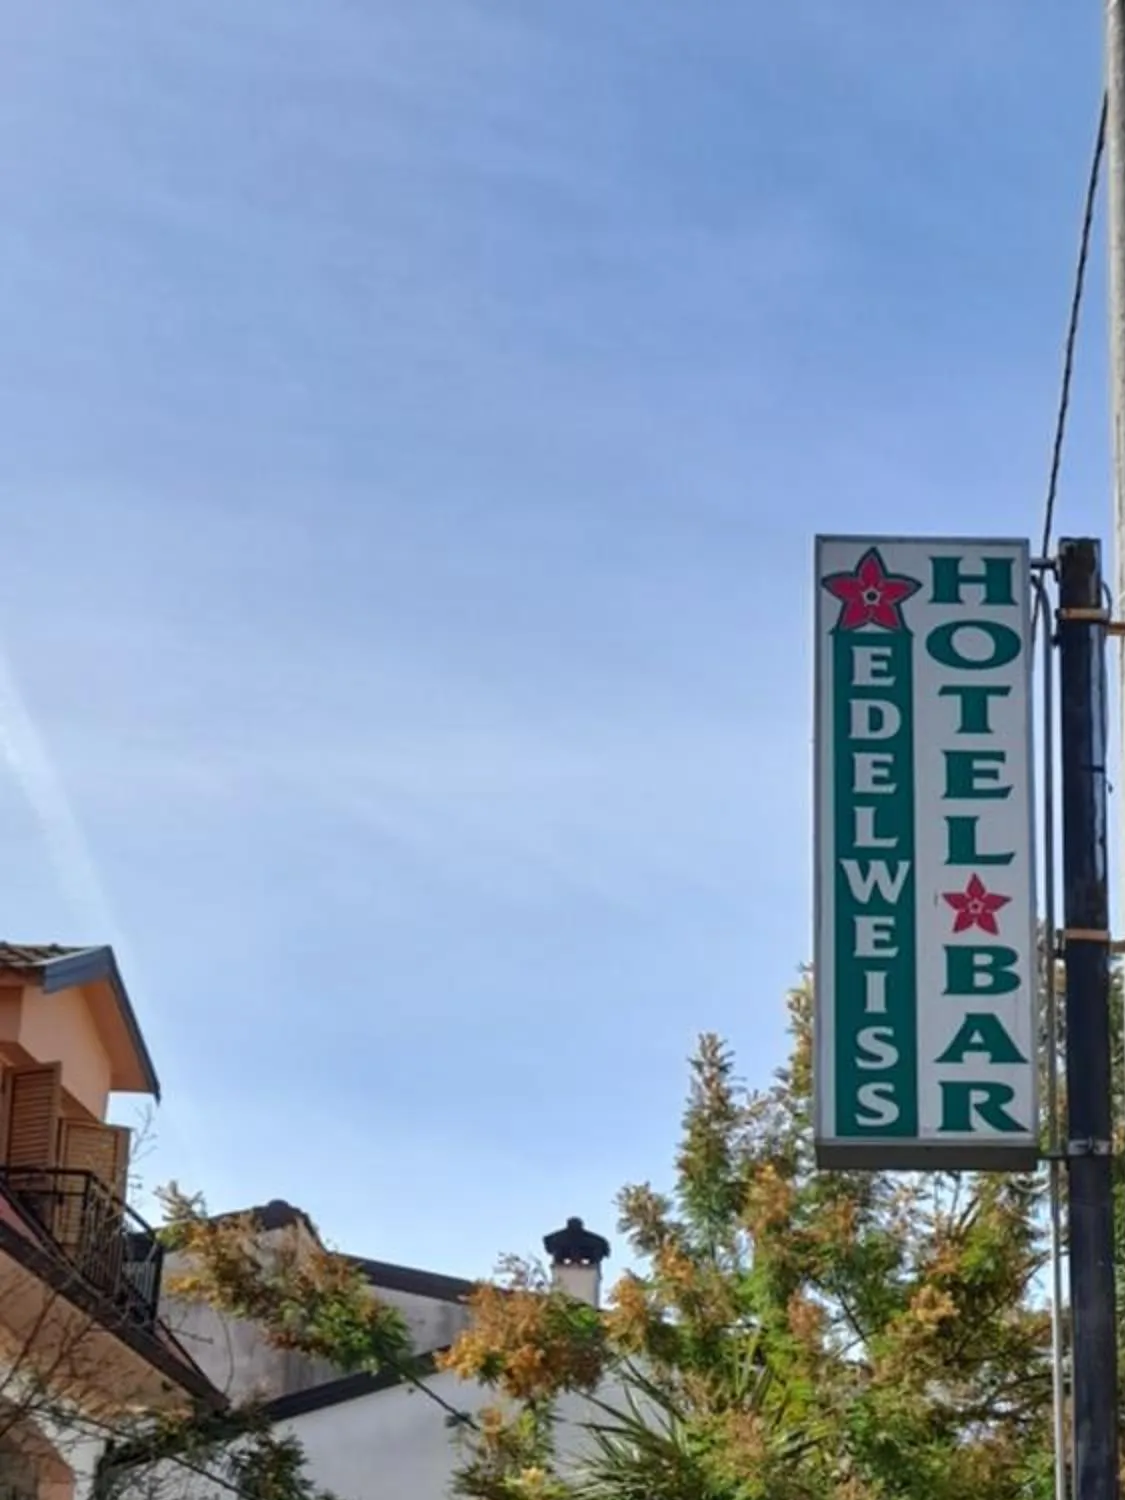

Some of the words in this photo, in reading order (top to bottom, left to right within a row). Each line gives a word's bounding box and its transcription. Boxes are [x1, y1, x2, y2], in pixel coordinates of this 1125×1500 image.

[926, 556, 1022, 866] HOTEL
[839, 645, 911, 1128] EDELWEISS
[934, 944, 1029, 1133] BAR
